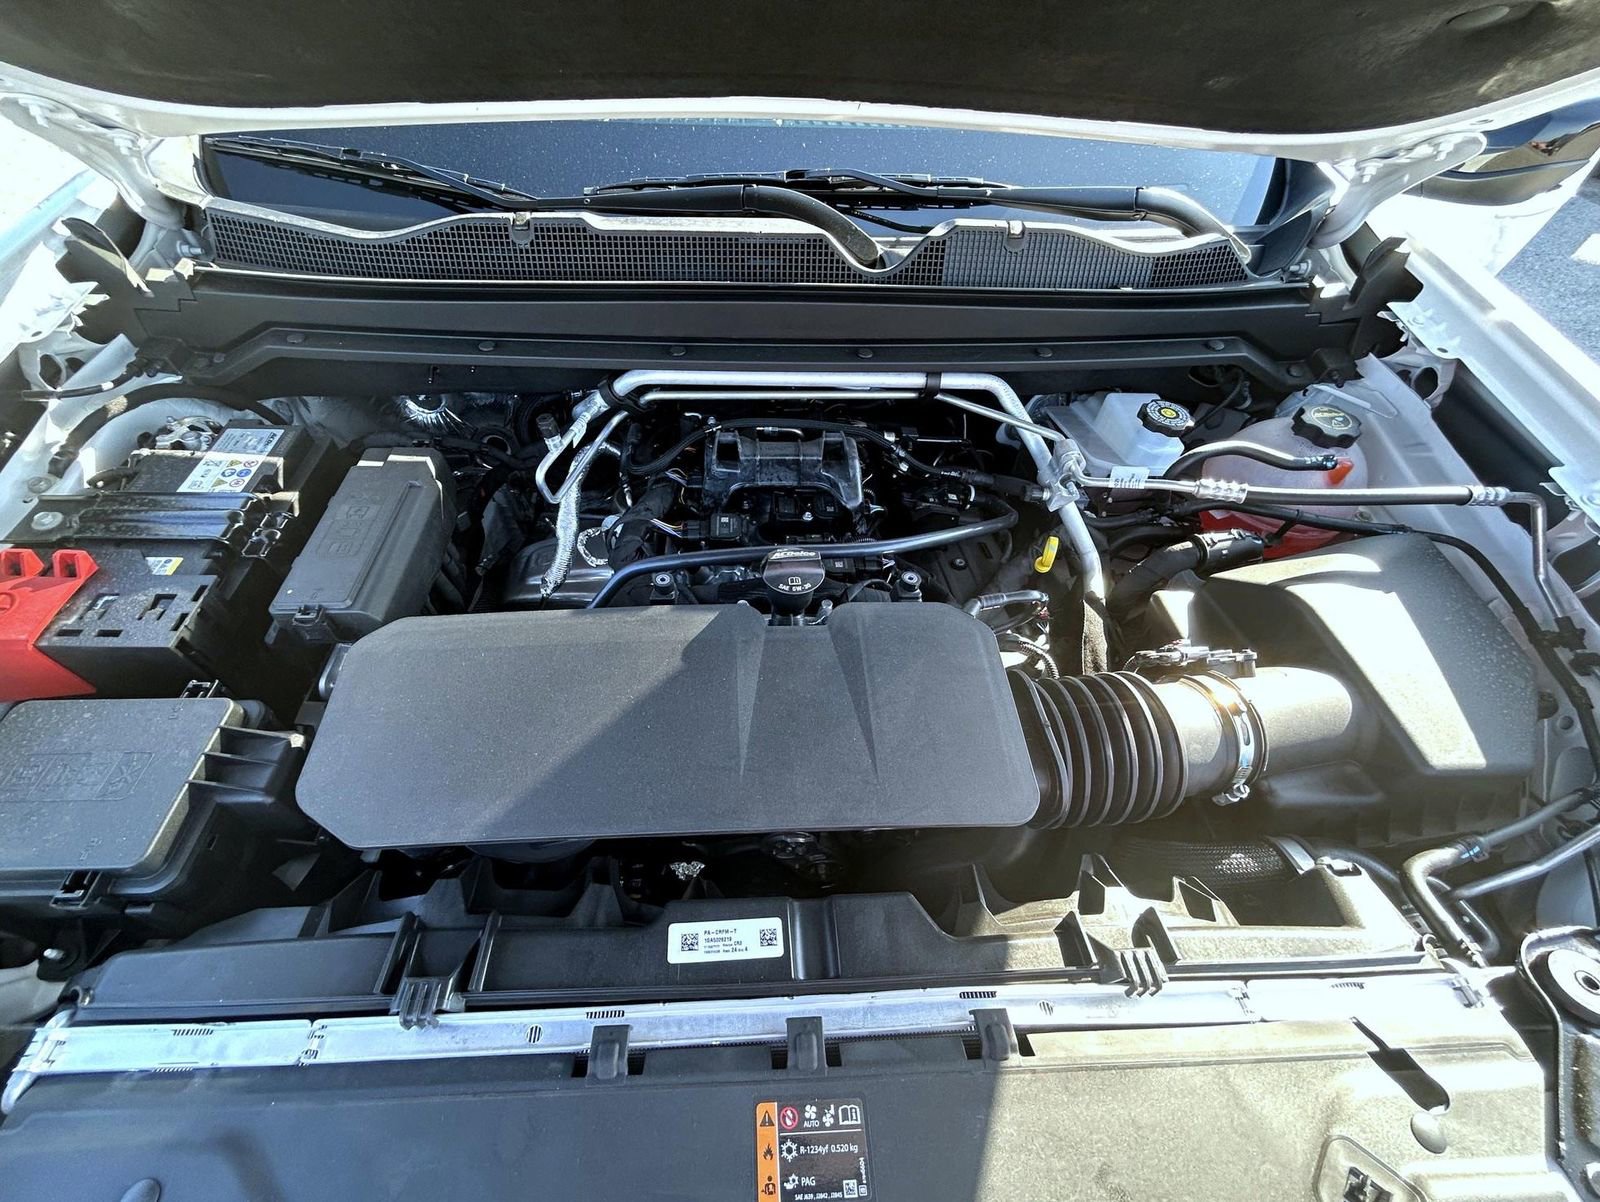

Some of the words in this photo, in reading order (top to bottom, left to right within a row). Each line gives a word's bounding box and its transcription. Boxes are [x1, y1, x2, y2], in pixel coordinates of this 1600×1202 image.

[769, 551, 816, 559] ACDelco
[803, 1120, 820, 1128] AUTO
[800, 1144, 829, 1156] R-1234yf
[831, 1143, 849, 1153] 0.520
[849, 1143, 858, 1154] kg
[801, 1176, 816, 1186] PAG
